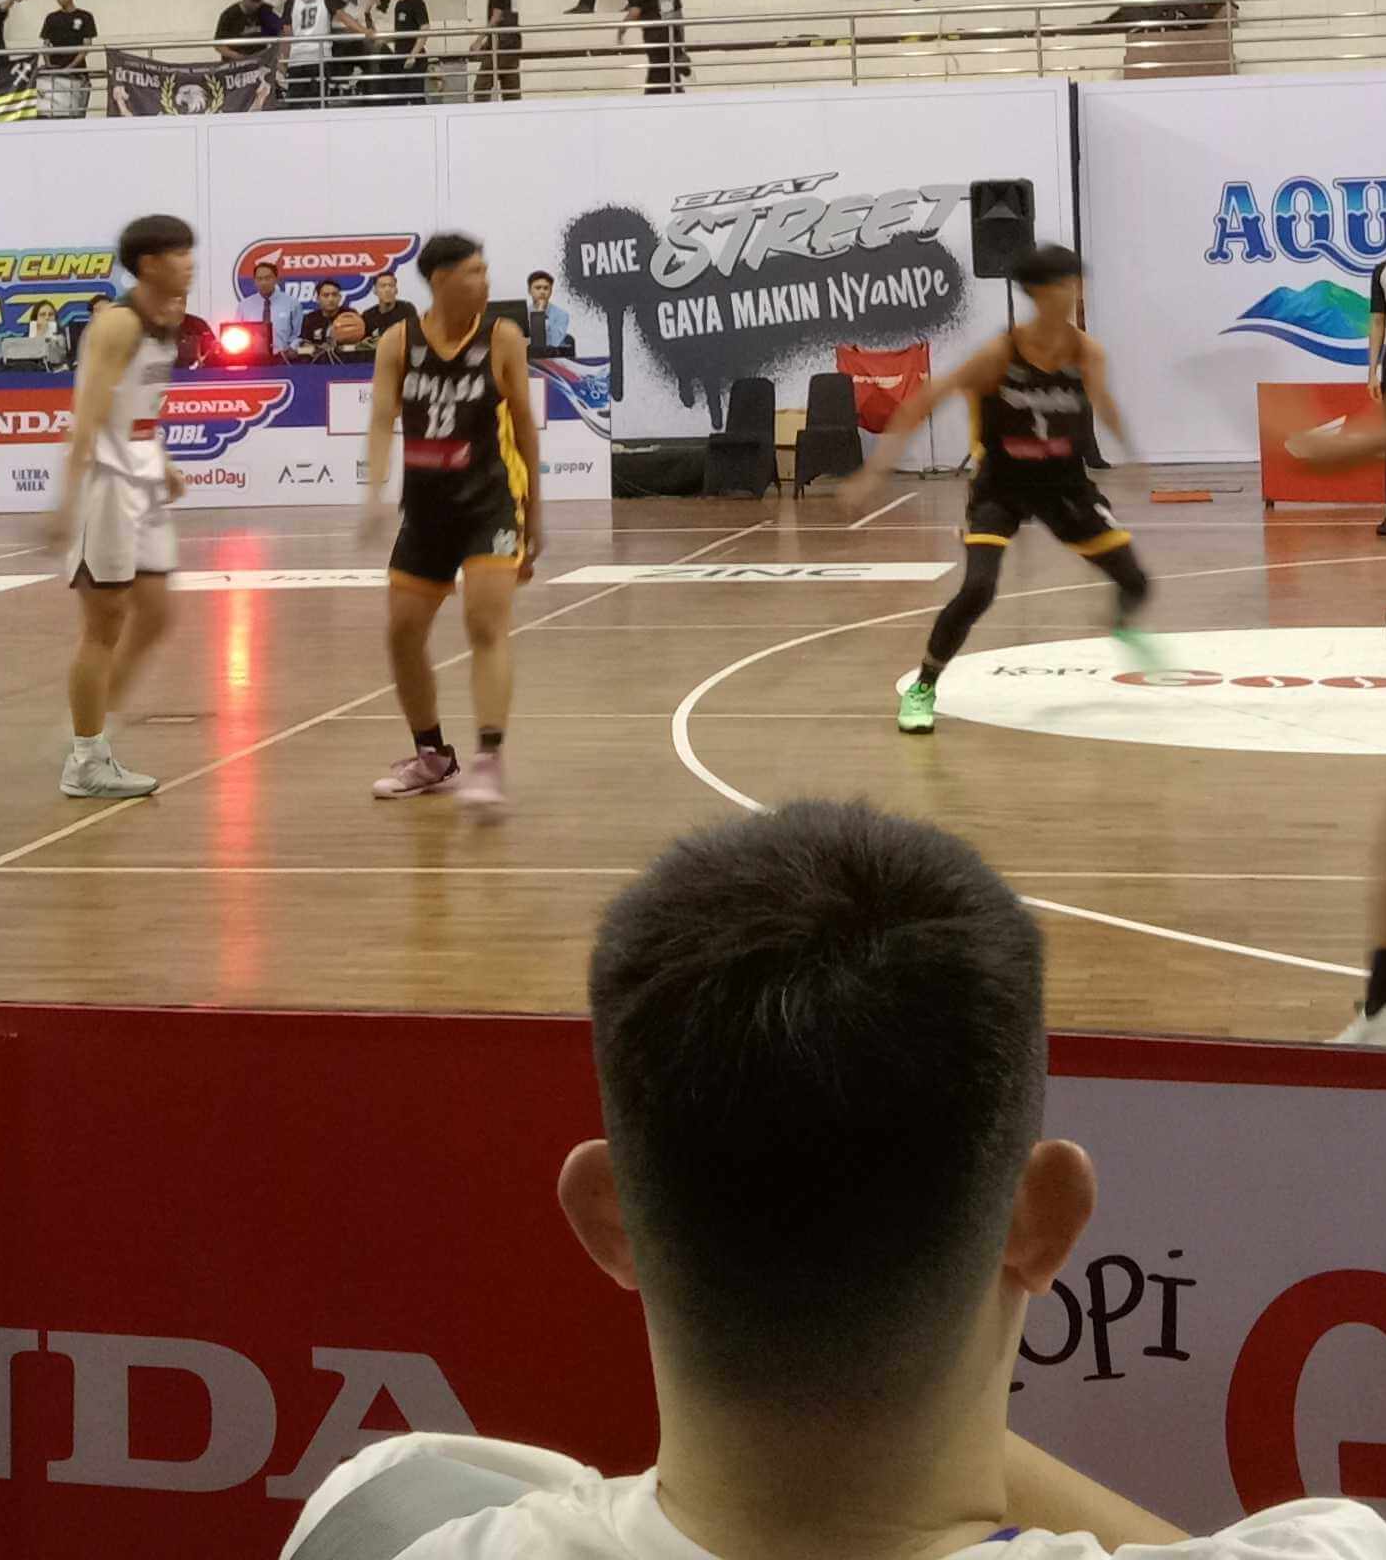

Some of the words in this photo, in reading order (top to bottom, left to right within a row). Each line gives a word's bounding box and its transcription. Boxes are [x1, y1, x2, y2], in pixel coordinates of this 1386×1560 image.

[649, 183, 972, 290] STREET
[18, 252, 115, 278] CUMA
[282, 252, 376, 269] HONDA
[579, 238, 642, 277] PAKE
[656, 294, 725, 340] GAYA
[730, 281, 820, 330] MAKIN
[166, 399, 252, 414] HONDA
[166, 423, 208, 445] DBL
[11, 468, 50, 480] ULTRA
[553, 460, 593, 475] gopay
[15, 480, 46, 491] MILK
[215, 469, 246, 488] Day
[633, 566, 873, 580] ZINC
